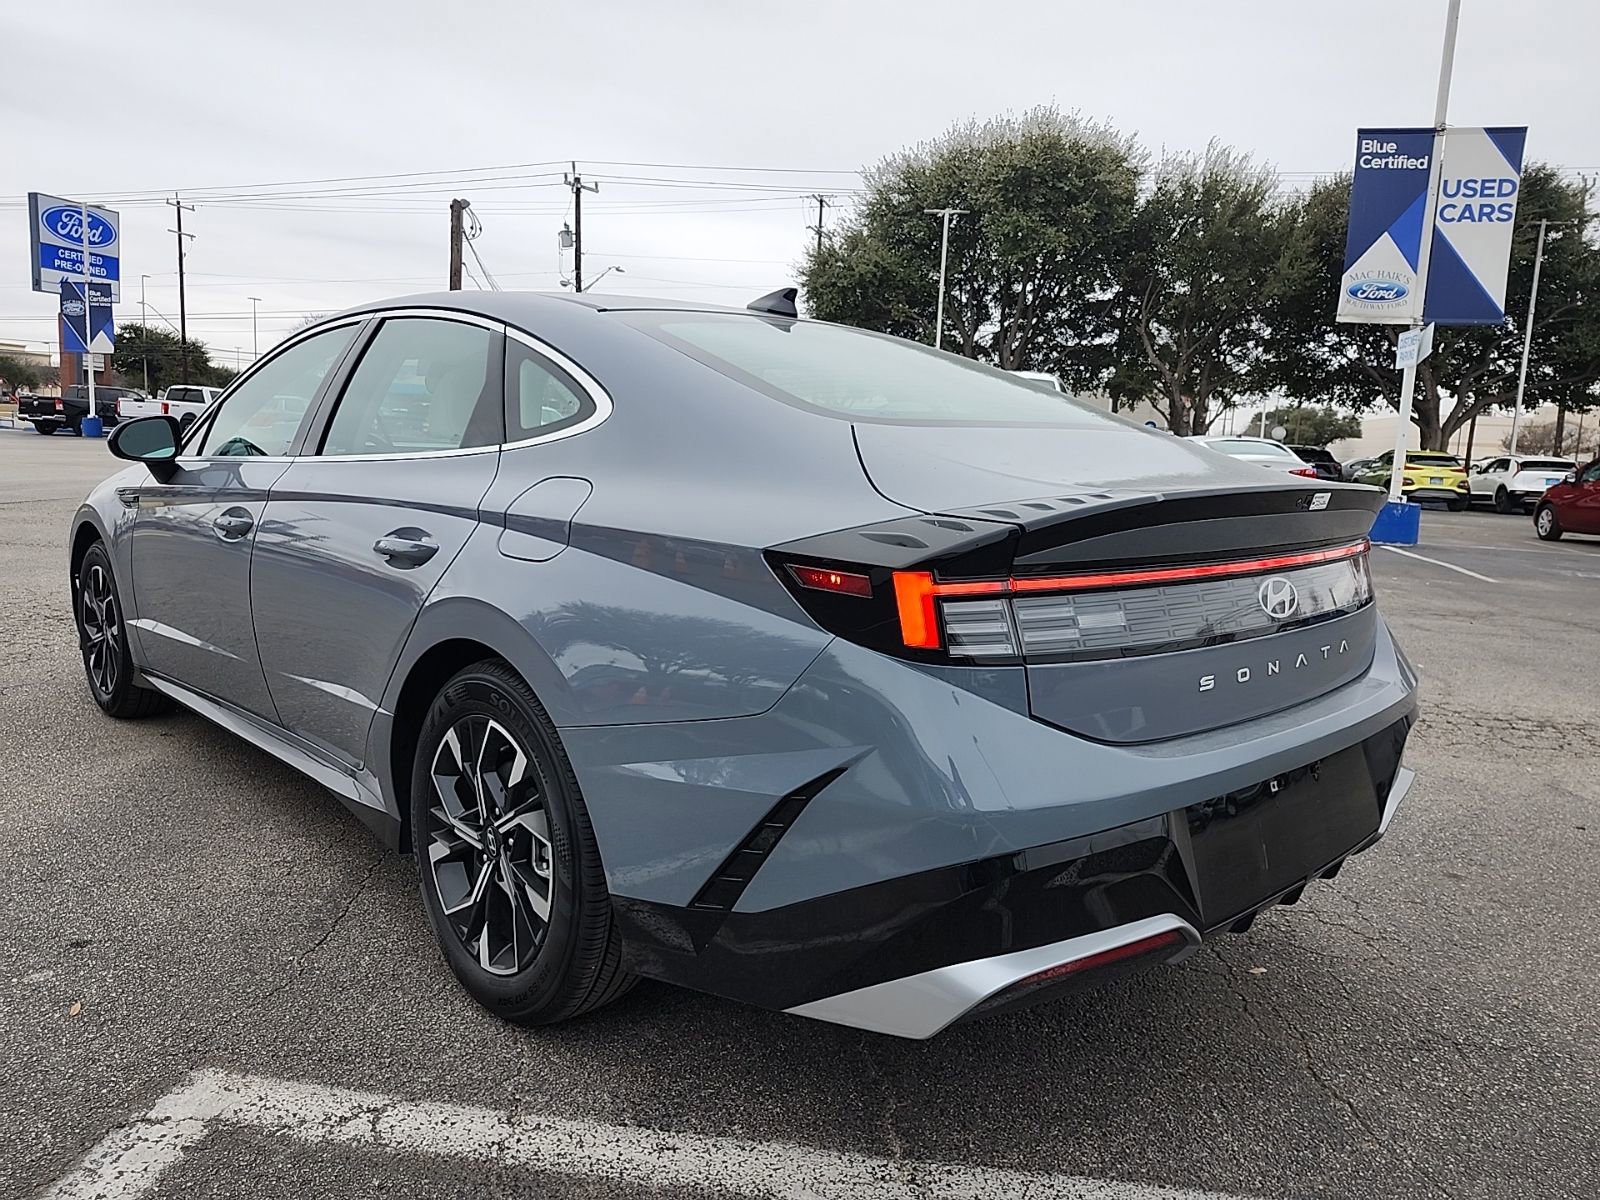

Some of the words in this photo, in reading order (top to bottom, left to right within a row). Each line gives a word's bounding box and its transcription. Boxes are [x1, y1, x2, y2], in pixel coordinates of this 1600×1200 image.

[1360, 139, 1397, 153] Blue
[1359, 155, 1429, 169] Certified
[1442, 178, 1518, 198] USED
[1439, 203, 1514, 223] CARS
[58, 249, 103, 265] CERTIIED
[1349, 270, 1374, 282] MAC
[1357, 282, 1398, 299] Ford
[1199, 639, 1349, 692] SONATA
